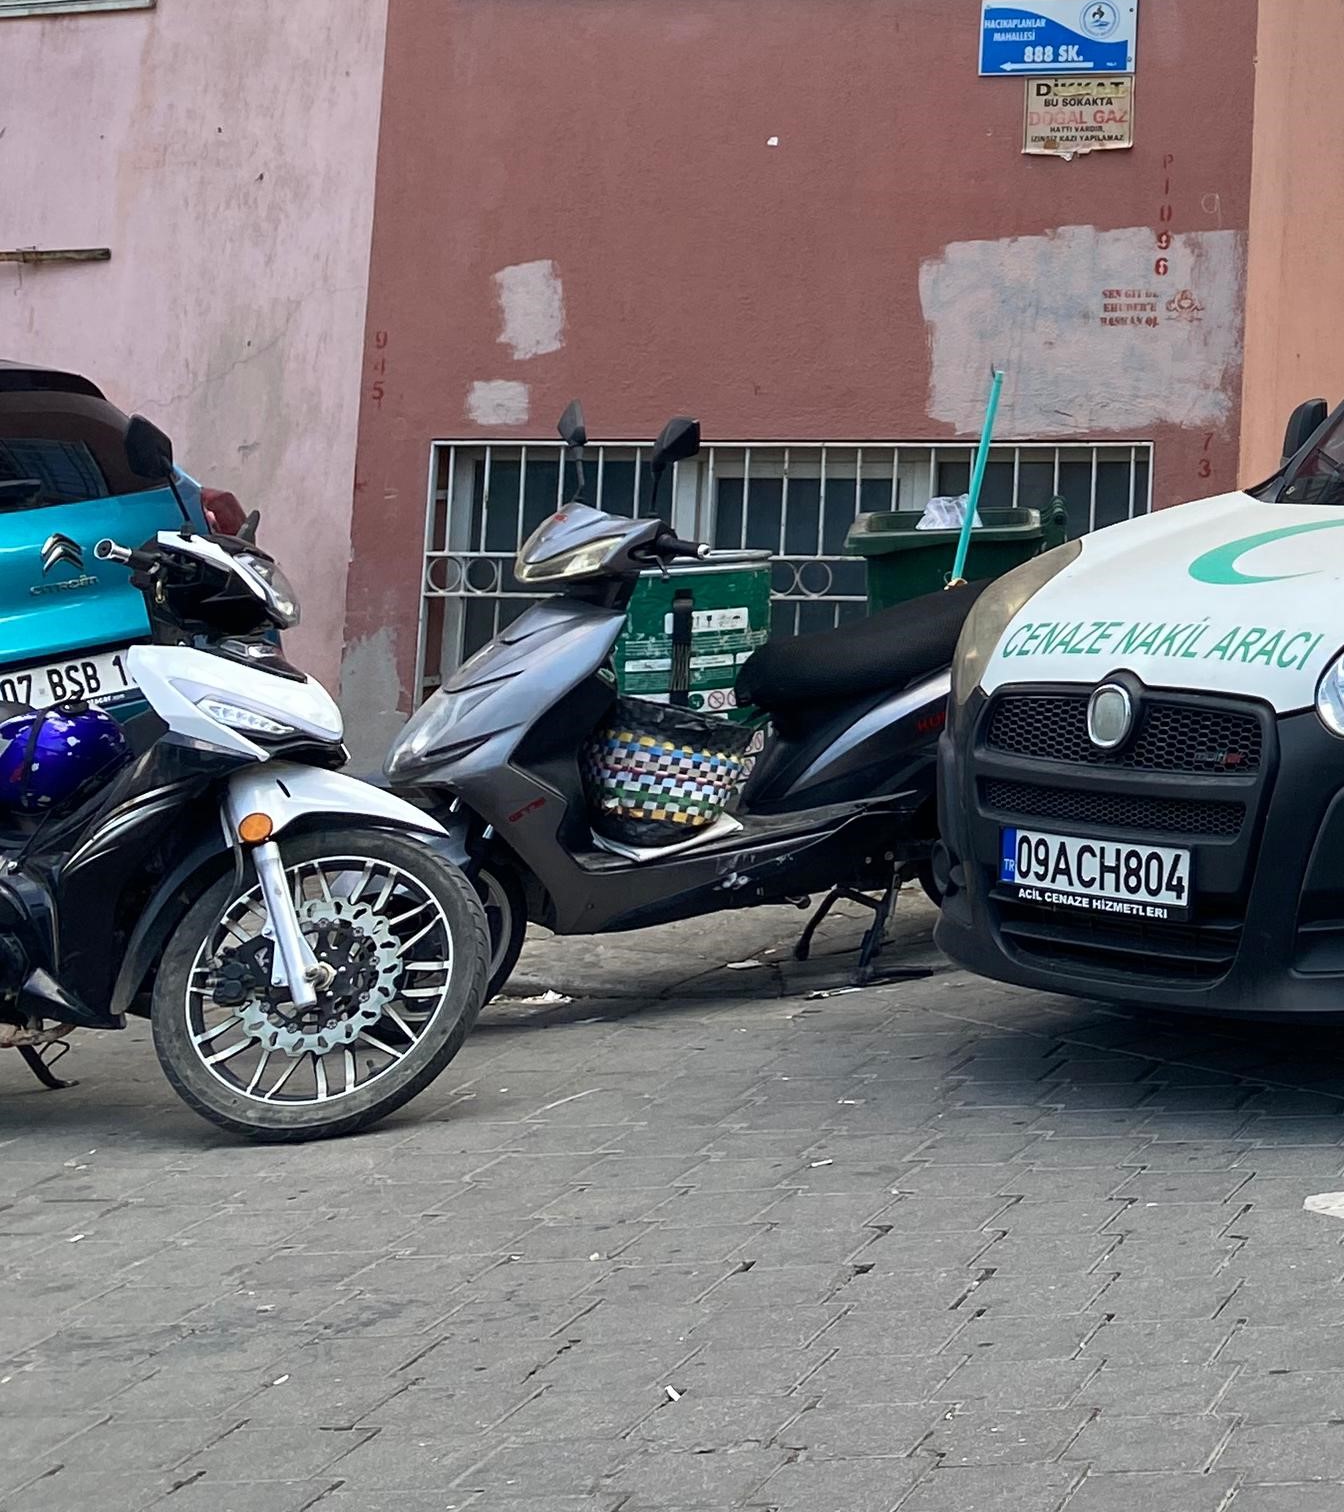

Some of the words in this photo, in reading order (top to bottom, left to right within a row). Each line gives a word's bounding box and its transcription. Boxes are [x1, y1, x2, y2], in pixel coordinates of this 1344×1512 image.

[993, 29, 1036, 42] MAHALLESİ
[1024, 46, 1053, 62] 888
[1058, 45, 1084, 62] SK.
[1044, 98, 1059, 107] BU
[1062, 97, 1113, 107] SOKAKTA
[1093, 109, 1128, 124] GAZ
[1002, 621, 1124, 658] CENAZE
[1110, 616, 1212, 659] NAKİL
[1206, 625, 1325, 671] ARACI
[46, 660, 102, 702] BSB
[1017, 834, 1186, 901] 09ACH804
[1018, 887, 1042, 901] ACİL
[1044, 893, 1090, 909] CENAZE
